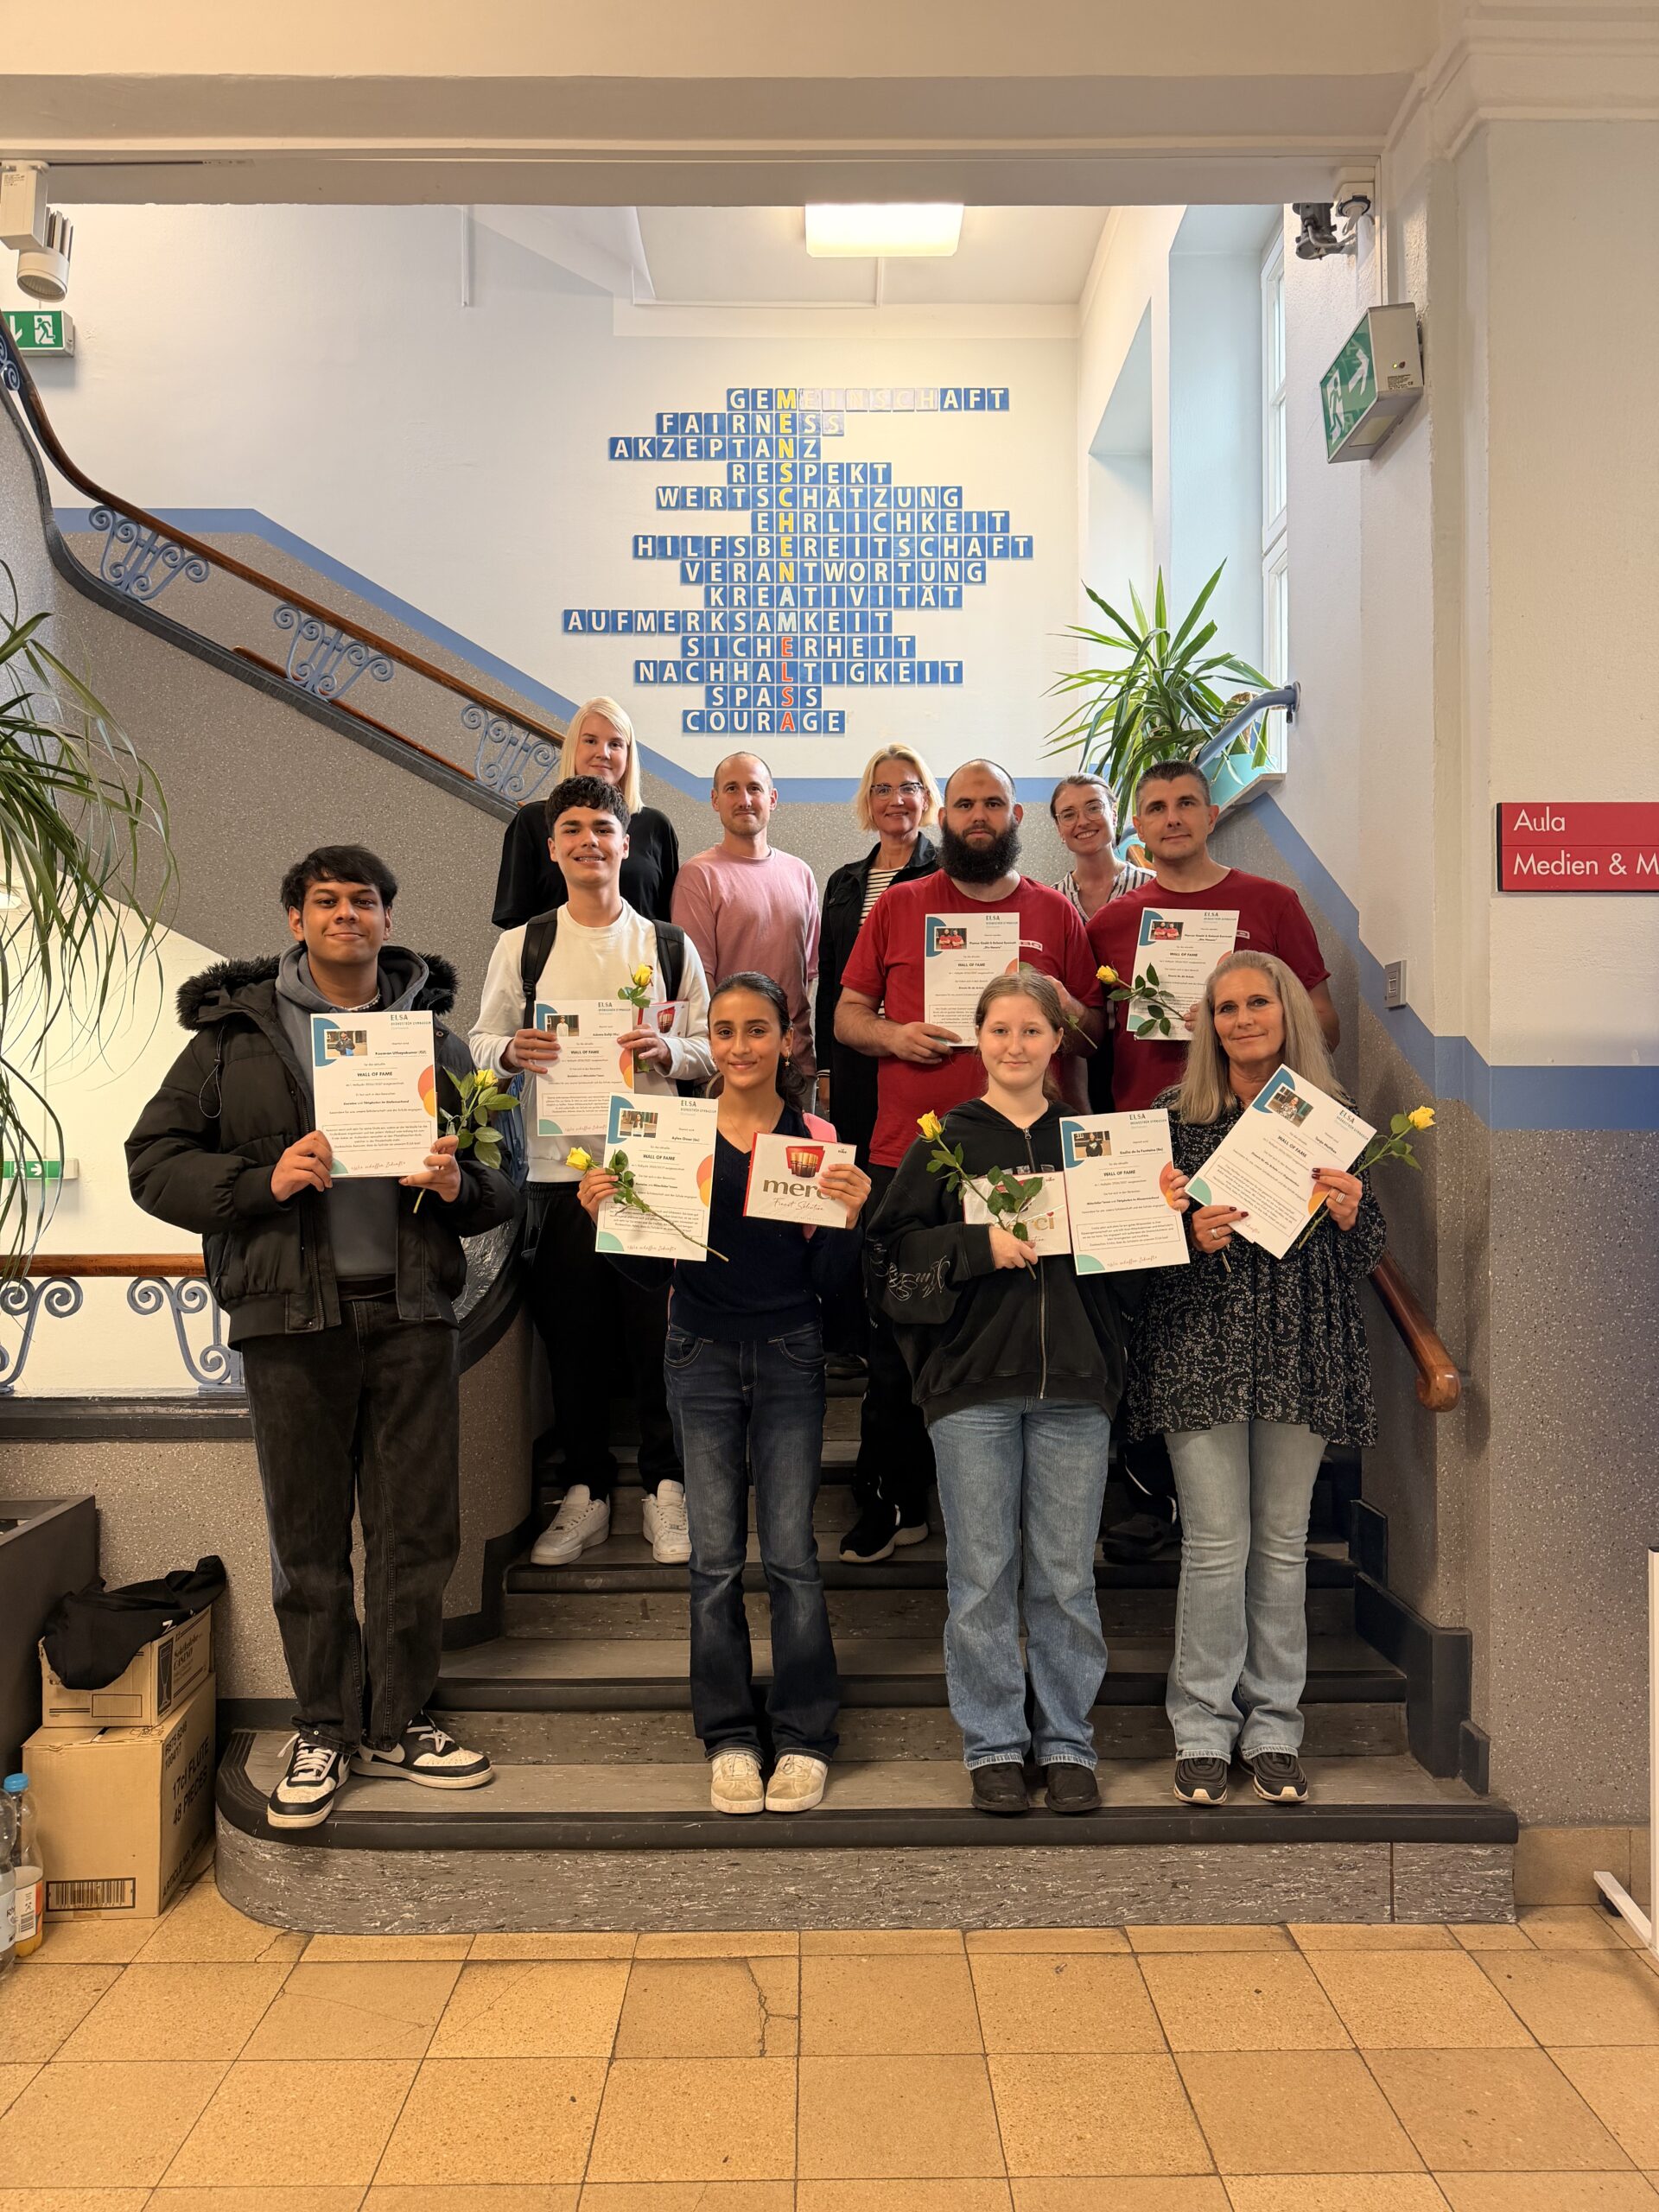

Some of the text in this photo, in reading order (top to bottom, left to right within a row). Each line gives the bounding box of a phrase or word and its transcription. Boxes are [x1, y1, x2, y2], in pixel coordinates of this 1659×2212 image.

[730, 389, 1005, 410] GEMEINSCHAFT
[663, 414, 840, 434] FAIRNESS
[613, 439, 817, 460] AKZEPTANZ
[733, 463, 888, 483] RESPEKT
[658, 486, 959, 507] WERTSCHÄTZUNG
[759, 512, 1006, 532] EHRLICHKEIT
[638, 536, 1029, 558] HILFSBEREITSCHAFT
[685, 562, 983, 582] VERANTWORTUNG
[711, 585, 959, 607] KREATIVITÄT
[568, 610, 888, 632] AUFMERKSAMKEIT
[687, 636, 911, 658] SICHERHEIT
[639, 661, 959, 683] NACHHALTIGKEIT
[713, 687, 818, 708] SPASS
[686, 711, 841, 732] COURAGE
[1514, 806, 1566, 832] Aula
[1514, 849, 1599, 875] Medien
[1609, 852, 1627, 875] &
